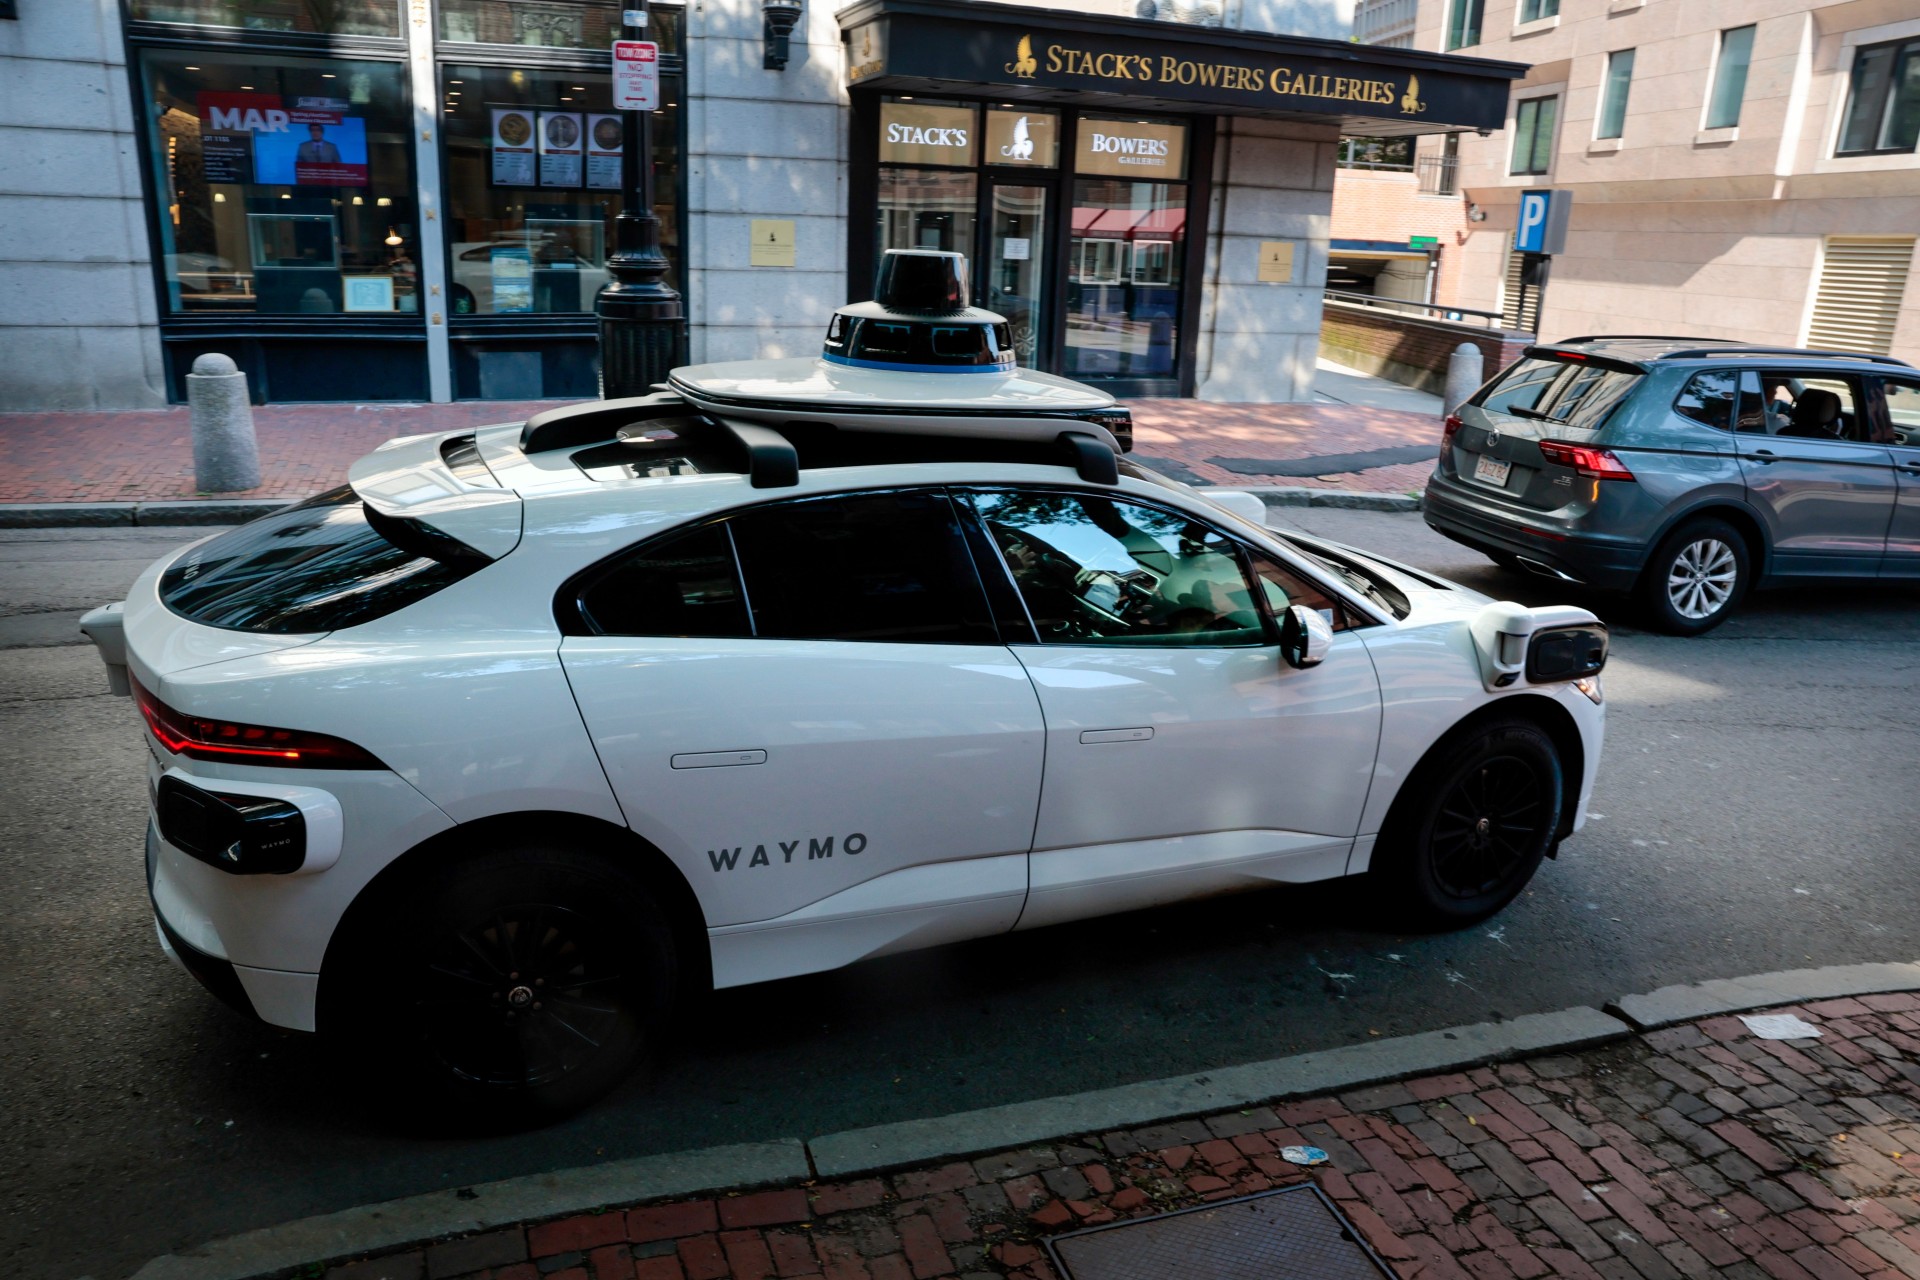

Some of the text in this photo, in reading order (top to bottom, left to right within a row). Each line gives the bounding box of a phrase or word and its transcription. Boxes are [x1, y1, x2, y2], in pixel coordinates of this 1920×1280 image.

[633, 48, 655, 59] ZONE
[1046, 44, 1395, 104] STACK'S BOWERS GALLERIES
[209, 106, 290, 132] MAR
[887, 122, 967, 147] STACK'S
[1091, 133, 1169, 156] BOWERS
[1519, 195, 1545, 247] P
[260, 838, 291, 850] WAYMO
[707, 832, 868, 873] WAYMO
